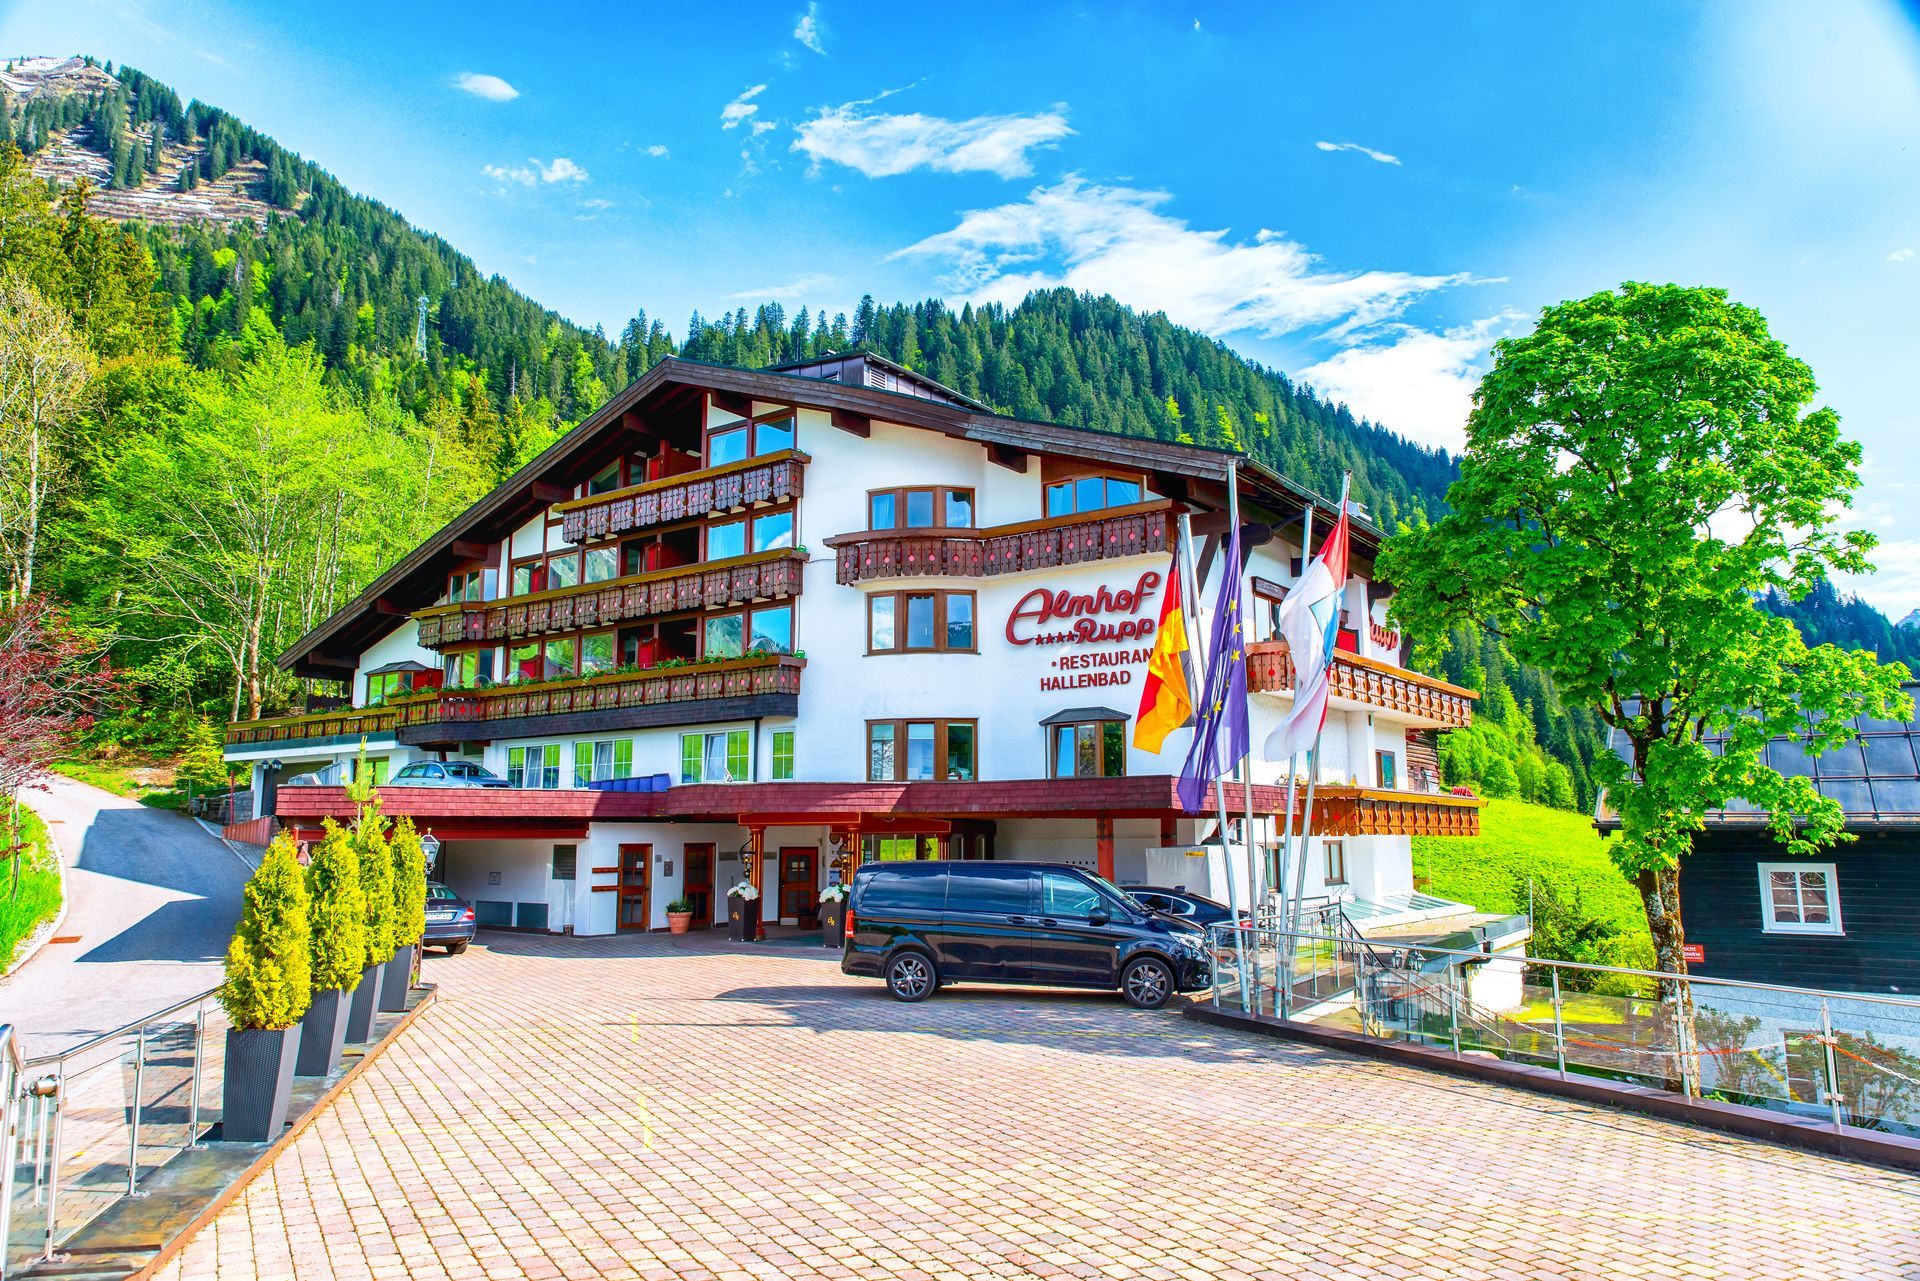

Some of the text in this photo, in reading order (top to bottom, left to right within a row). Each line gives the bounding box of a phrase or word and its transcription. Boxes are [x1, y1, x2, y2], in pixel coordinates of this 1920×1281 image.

[1006, 571, 1161, 645] Almhof
[1073, 618, 1155, 644] Rupp
[1059, 648, 1154, 670] RESTAURAN
[1040, 670, 1131, 691] HALLENBAD
